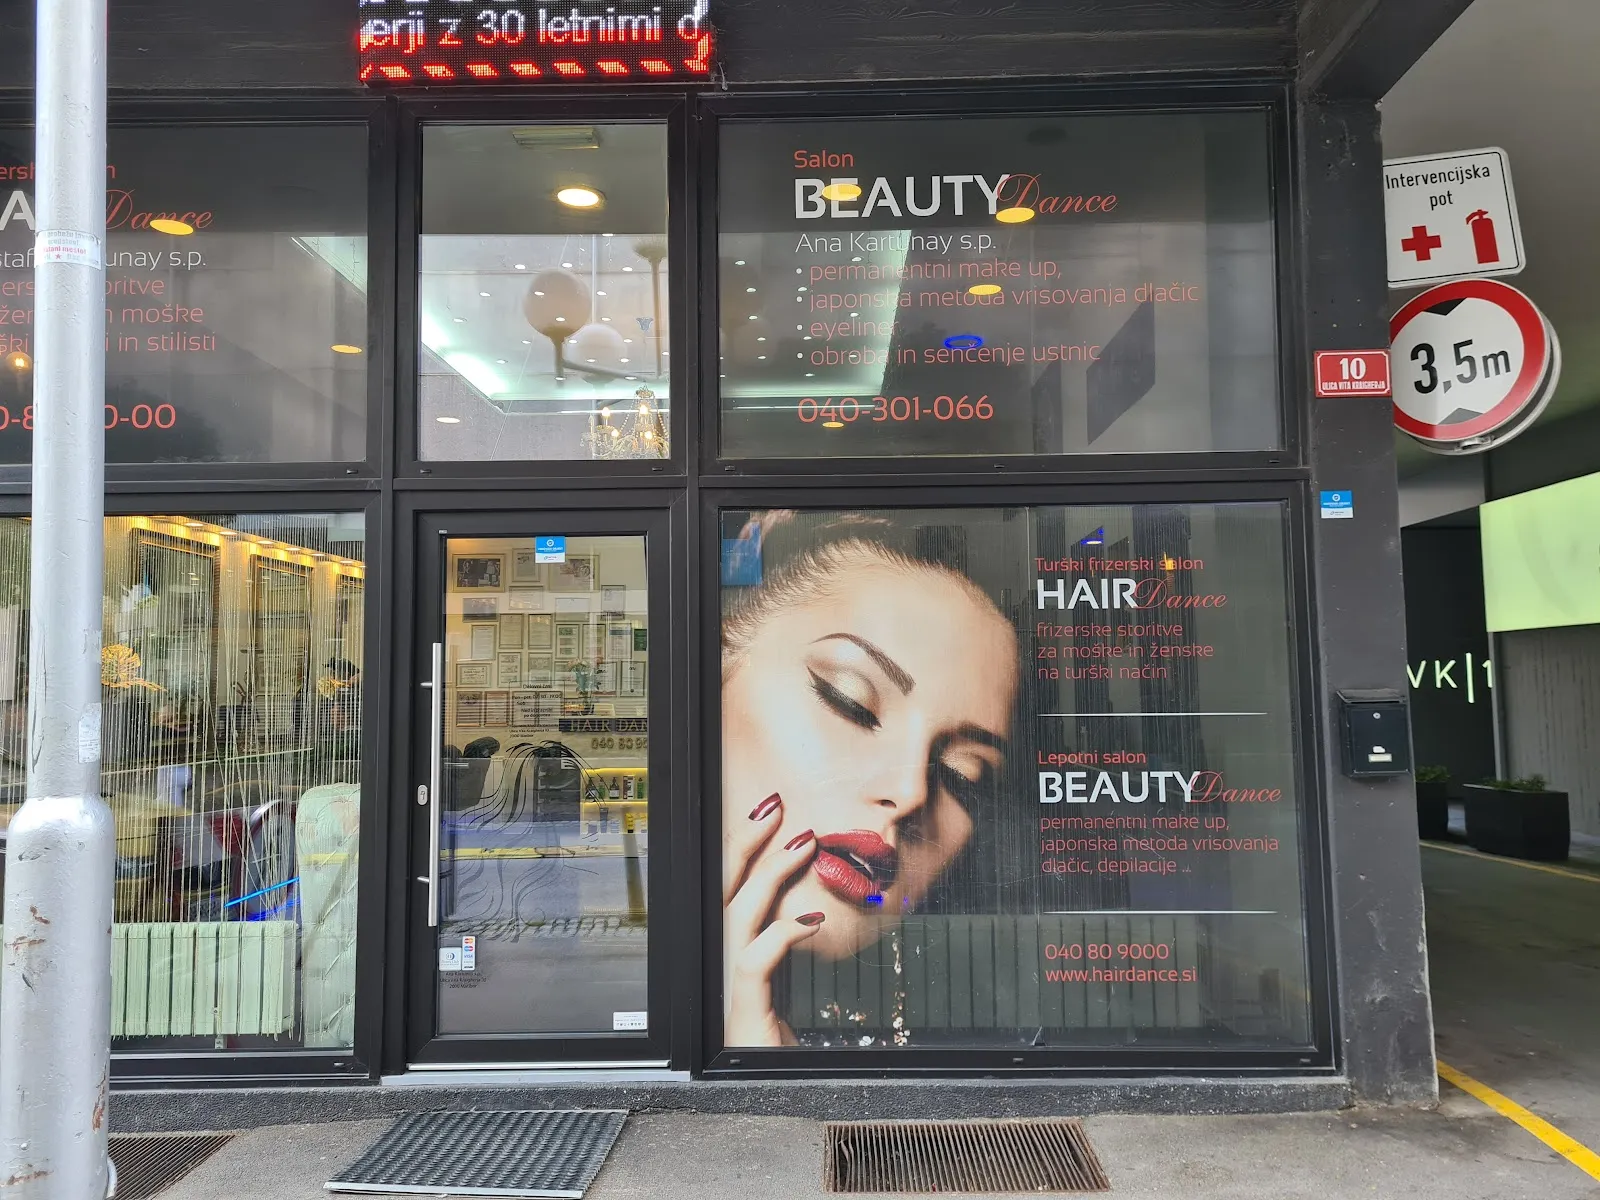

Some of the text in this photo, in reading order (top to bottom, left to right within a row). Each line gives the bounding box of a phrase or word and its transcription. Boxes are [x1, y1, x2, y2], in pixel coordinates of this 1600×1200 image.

[439, 19, 461, 44] z
[476, 9, 525, 44] 30
[538, 7, 662, 43] letnimi
[793, 150, 854, 168] Salon
[1385, 163, 1491, 190] Intervencijska
[794, 174, 1119, 219] BEAUTY Dance
[1429, 191, 1454, 211] pot
[795, 232, 997, 256] Ana Kartunay s.p.
[169, 250, 207, 270] s.p.
[809, 259, 1063, 284] permanentni make up,
[809, 282, 1199, 312] japonska metoda vrisovanja dlačic
[122, 303, 204, 323] moške
[809, 319, 898, 341] eyeliner
[119, 332, 138, 352] in
[147, 331, 216, 352] stilisti
[810, 341, 1101, 367] obroba in senčenje ustnic
[1339, 357, 1366, 380] 10
[797, 395, 994, 423] 040-301-066
[1034, 555, 1204, 572] Turški frizerski salon
[1037, 577, 1228, 610] HAIR Dance
[1036, 622, 1184, 638] frizerske storitve
[1037, 641, 1215, 659] za moške in ženske
[1037, 663, 1167, 680] na turški način
[569, 719, 612, 732] HAIR
[1038, 749, 1147, 767] Lepotni salon
[1038, 770, 1283, 804] BEAUTY Dance
[1040, 814, 1231, 832] permanentni make up,
[1041, 835, 1280, 853] japonska metoda vrisovanja
[1041, 857, 1093, 875] dlačic,
[1097, 856, 1177, 875] depilacije
[1044, 943, 1170, 960] 040 80 9000
[1045, 966, 1197, 982] www.hairdance.si
